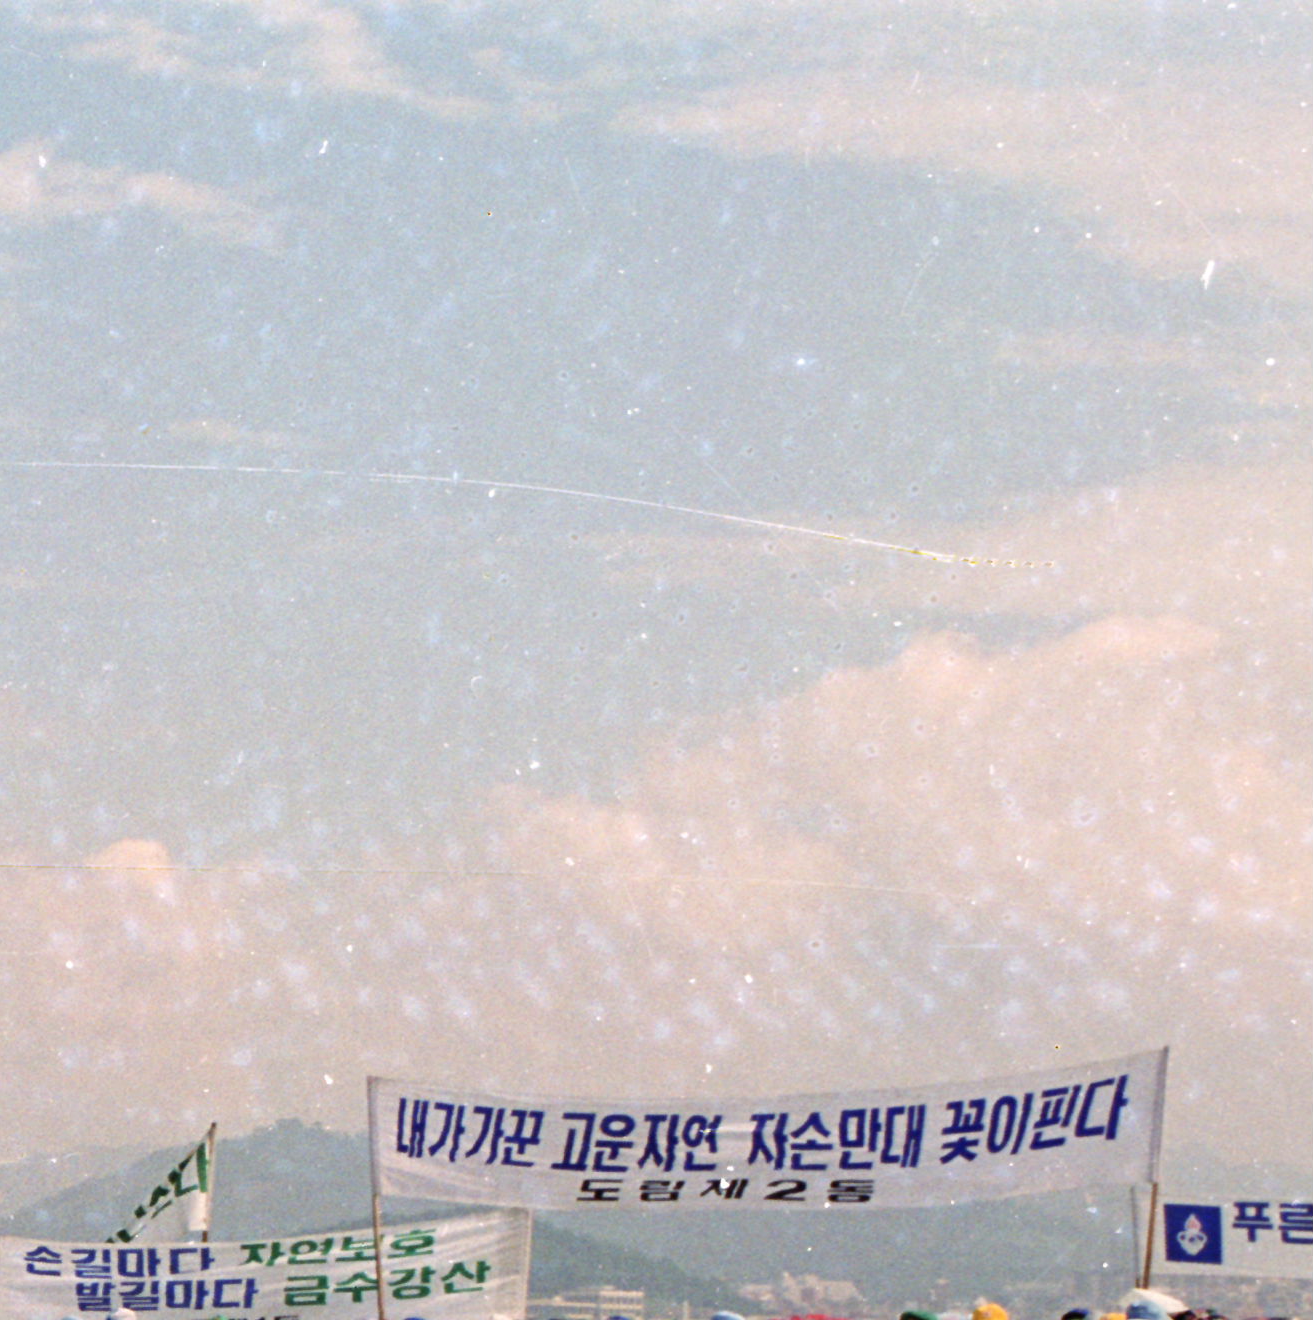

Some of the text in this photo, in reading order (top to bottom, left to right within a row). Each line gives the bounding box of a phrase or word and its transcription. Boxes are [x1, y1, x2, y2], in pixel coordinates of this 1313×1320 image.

[396, 1074, 1129, 1173] 내가가꾼 고운자연 자손만대 꽃이핀다
[577, 1177, 875, 1204] 도림제2동
[24, 1229, 437, 1279] 손길마다 자연보호
[75, 1260, 492, 1311] 발길마다 금수강산
